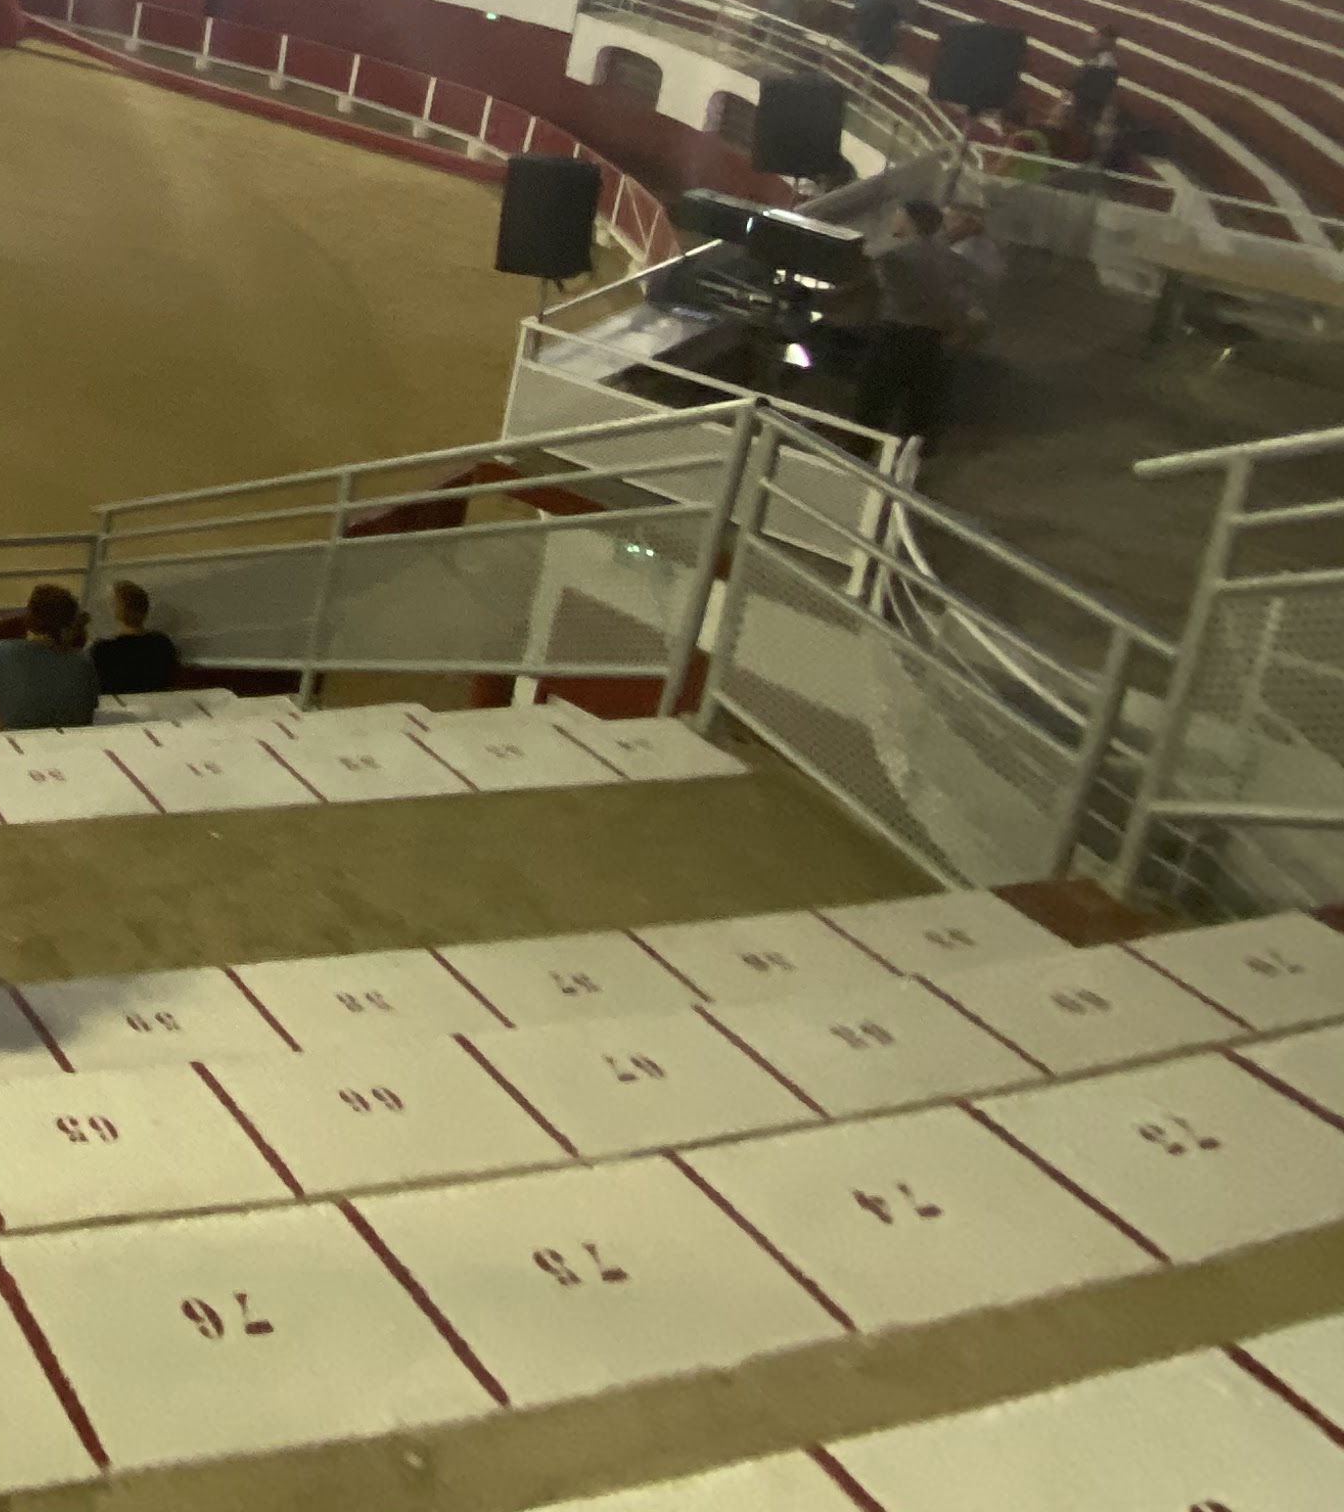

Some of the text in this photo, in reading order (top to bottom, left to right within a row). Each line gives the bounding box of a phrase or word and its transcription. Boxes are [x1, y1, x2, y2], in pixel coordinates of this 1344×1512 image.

[604, 1055, 666, 1083] 67
[338, 1087, 405, 1113] 66
[852, 1183, 943, 1225] 74
[532, 1243, 629, 1287] 75
[180, 1292, 275, 1339] 76
